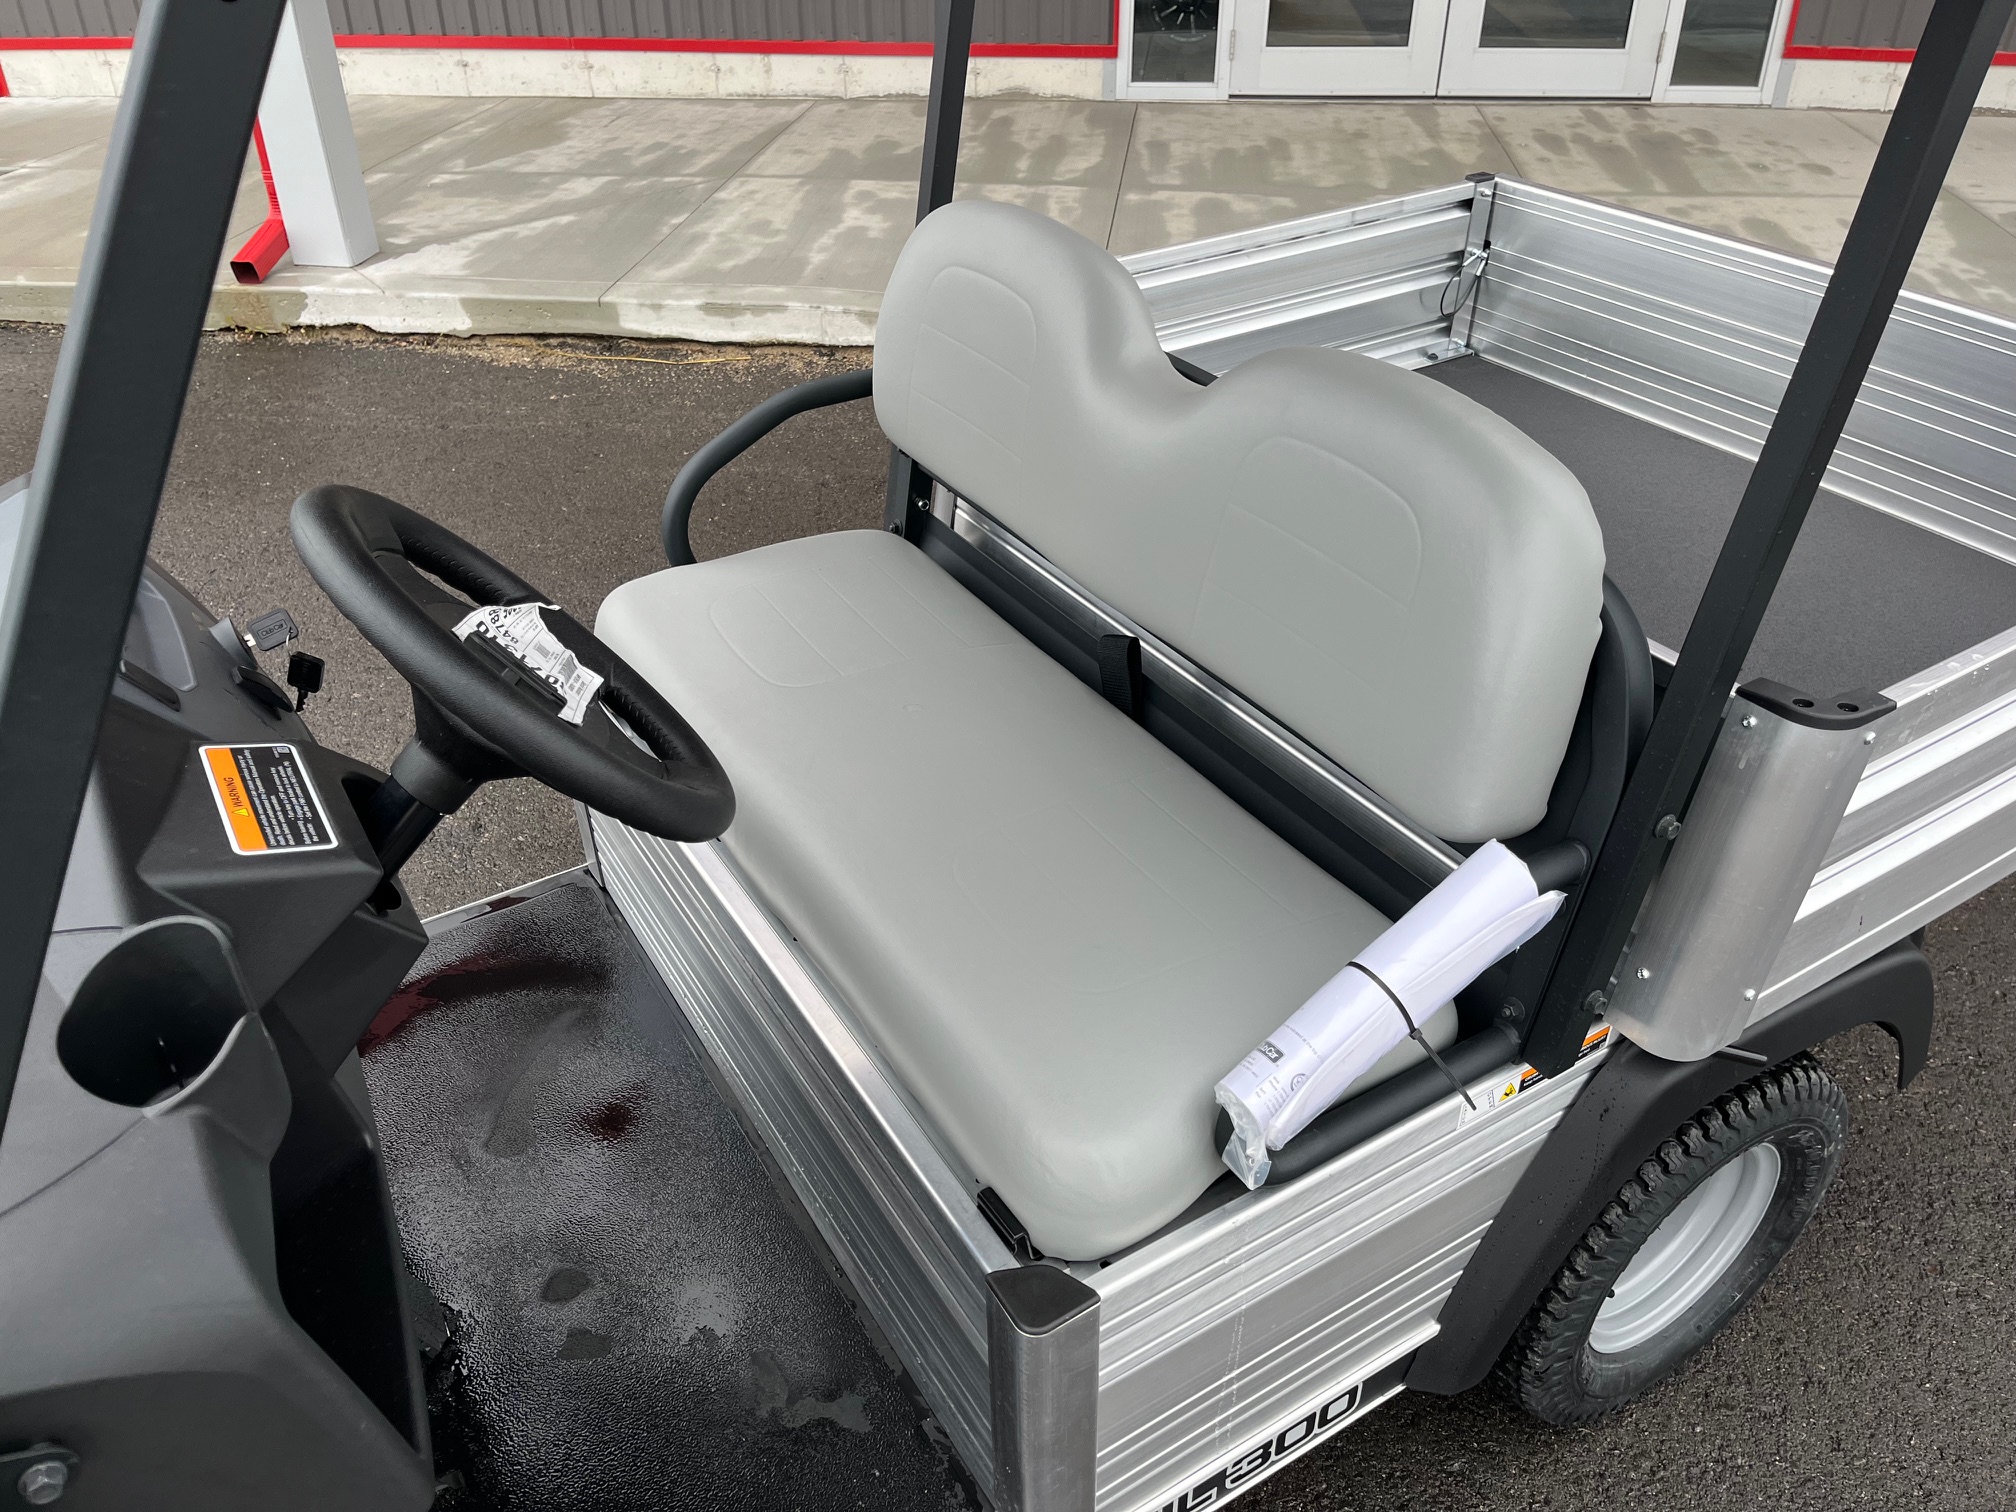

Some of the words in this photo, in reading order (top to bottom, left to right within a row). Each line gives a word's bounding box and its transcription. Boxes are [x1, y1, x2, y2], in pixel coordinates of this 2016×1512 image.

[261, 628, 275, 637] Club
[274, 623, 284, 631] Car
[223, 777, 243, 807] WARNING
[1265, 1047, 1279, 1059] Car
[1225, 1382, 1361, 1489] 300
